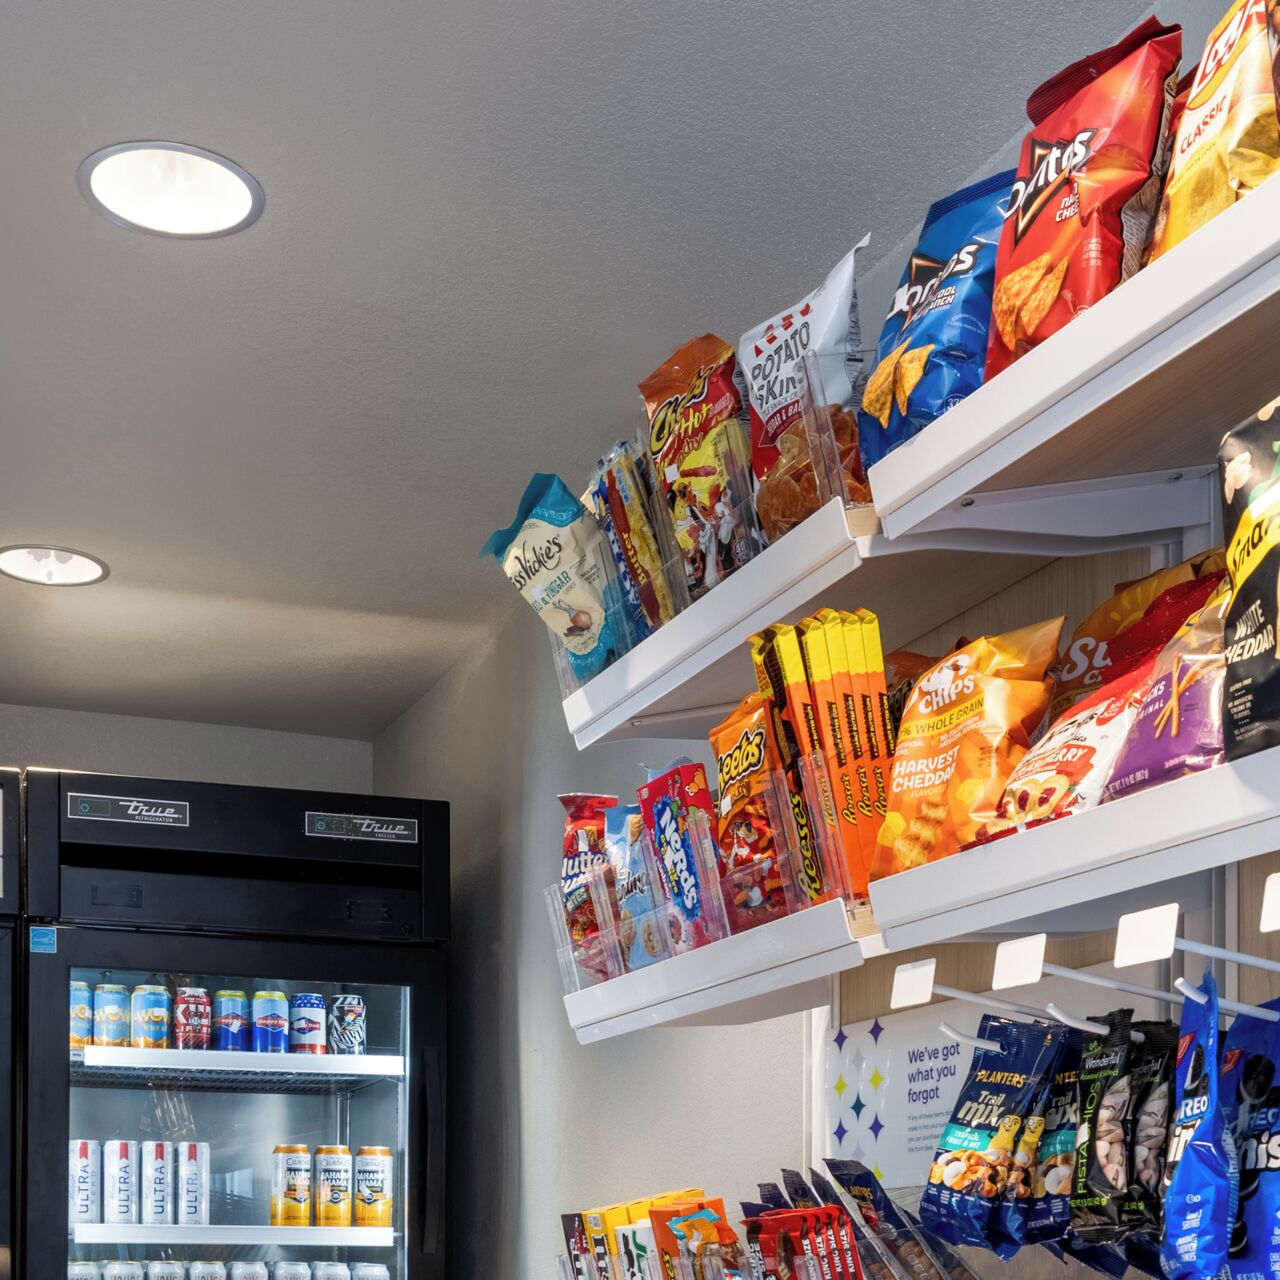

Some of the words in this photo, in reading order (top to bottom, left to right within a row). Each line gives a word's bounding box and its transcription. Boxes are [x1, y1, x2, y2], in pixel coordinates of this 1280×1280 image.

[1180, 96, 1227, 155] CLASSIC
[751, 321, 810, 382] POTATO
[515, 536, 563, 581] Vickie's
[1234, 600, 1265, 641] WHITE
[919, 674, 975, 714] CHIPS
[916, 713, 954, 735] WHOLE
[956, 698, 984, 720] GRAIN
[719, 729, 765, 793] heetos
[893, 745, 960, 778] HARVEST
[119, 800, 184, 819] true
[135, 815, 174, 824] REFRIGERATOR
[352, 818, 411, 835] true
[258, 1018, 277, 1026] Happy
[908, 1046, 939, 1064] We've
[942, 1042, 960, 1061] got
[1085, 1054, 1121, 1070] Wonderful
[908, 1066, 934, 1083] what
[936, 1064, 956, 1082] you
[975, 1069, 1026, 1088] PLANTERS
[908, 1086, 939, 1105] forgot
[978, 1090, 1006, 1106] Trail
[1179, 1096, 1209, 1118] REO
[78, 1164, 89, 1214] ULTRA
[119, 1164, 131, 1214] ULTRA
[154, 1165, 166, 1215] ULTRA
[802, 1238, 811, 1260] SIZE
[816, 1235, 826, 1258] SIZE
[827, 1229, 836, 1249] SIZE
[840, 1229, 850, 1249] SIZE
[749, 1243, 759, 1276] KING
[820, 1258, 831, 1280] KING
[833, 1250, 843, 1273] KING
[845, 1250, 856, 1273] KING
